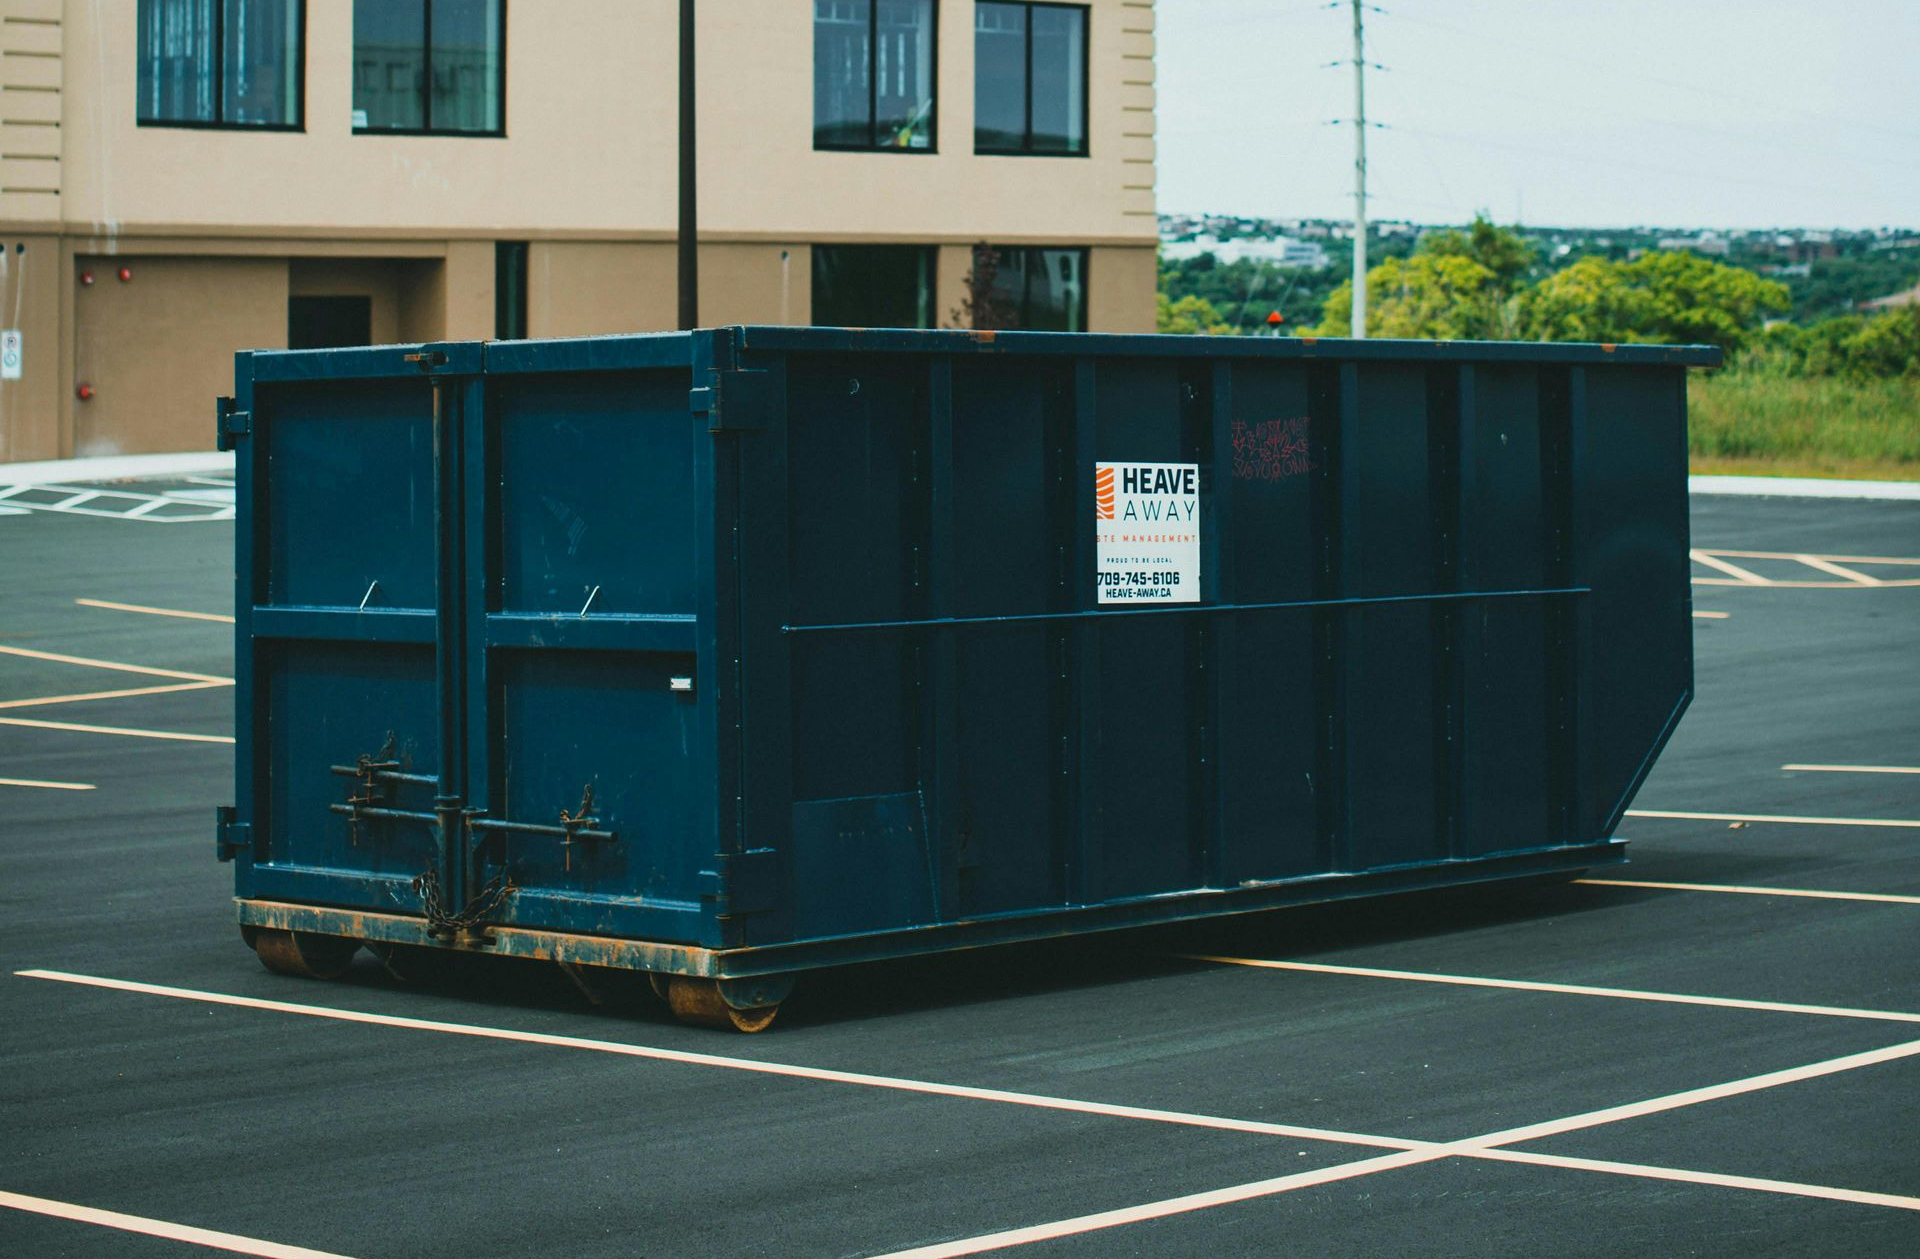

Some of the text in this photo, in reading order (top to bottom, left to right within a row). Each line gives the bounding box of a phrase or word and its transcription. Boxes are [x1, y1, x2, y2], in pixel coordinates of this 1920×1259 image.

[1123, 467, 1195, 494] HEAVE
[1123, 500, 1195, 521] AWAY
[1122, 534, 1196, 542] MANAGEMENT
[1097, 571, 1180, 585] 709-745-6106
[1106, 588, 1172, 598] HEAVE-AWAY.CA
